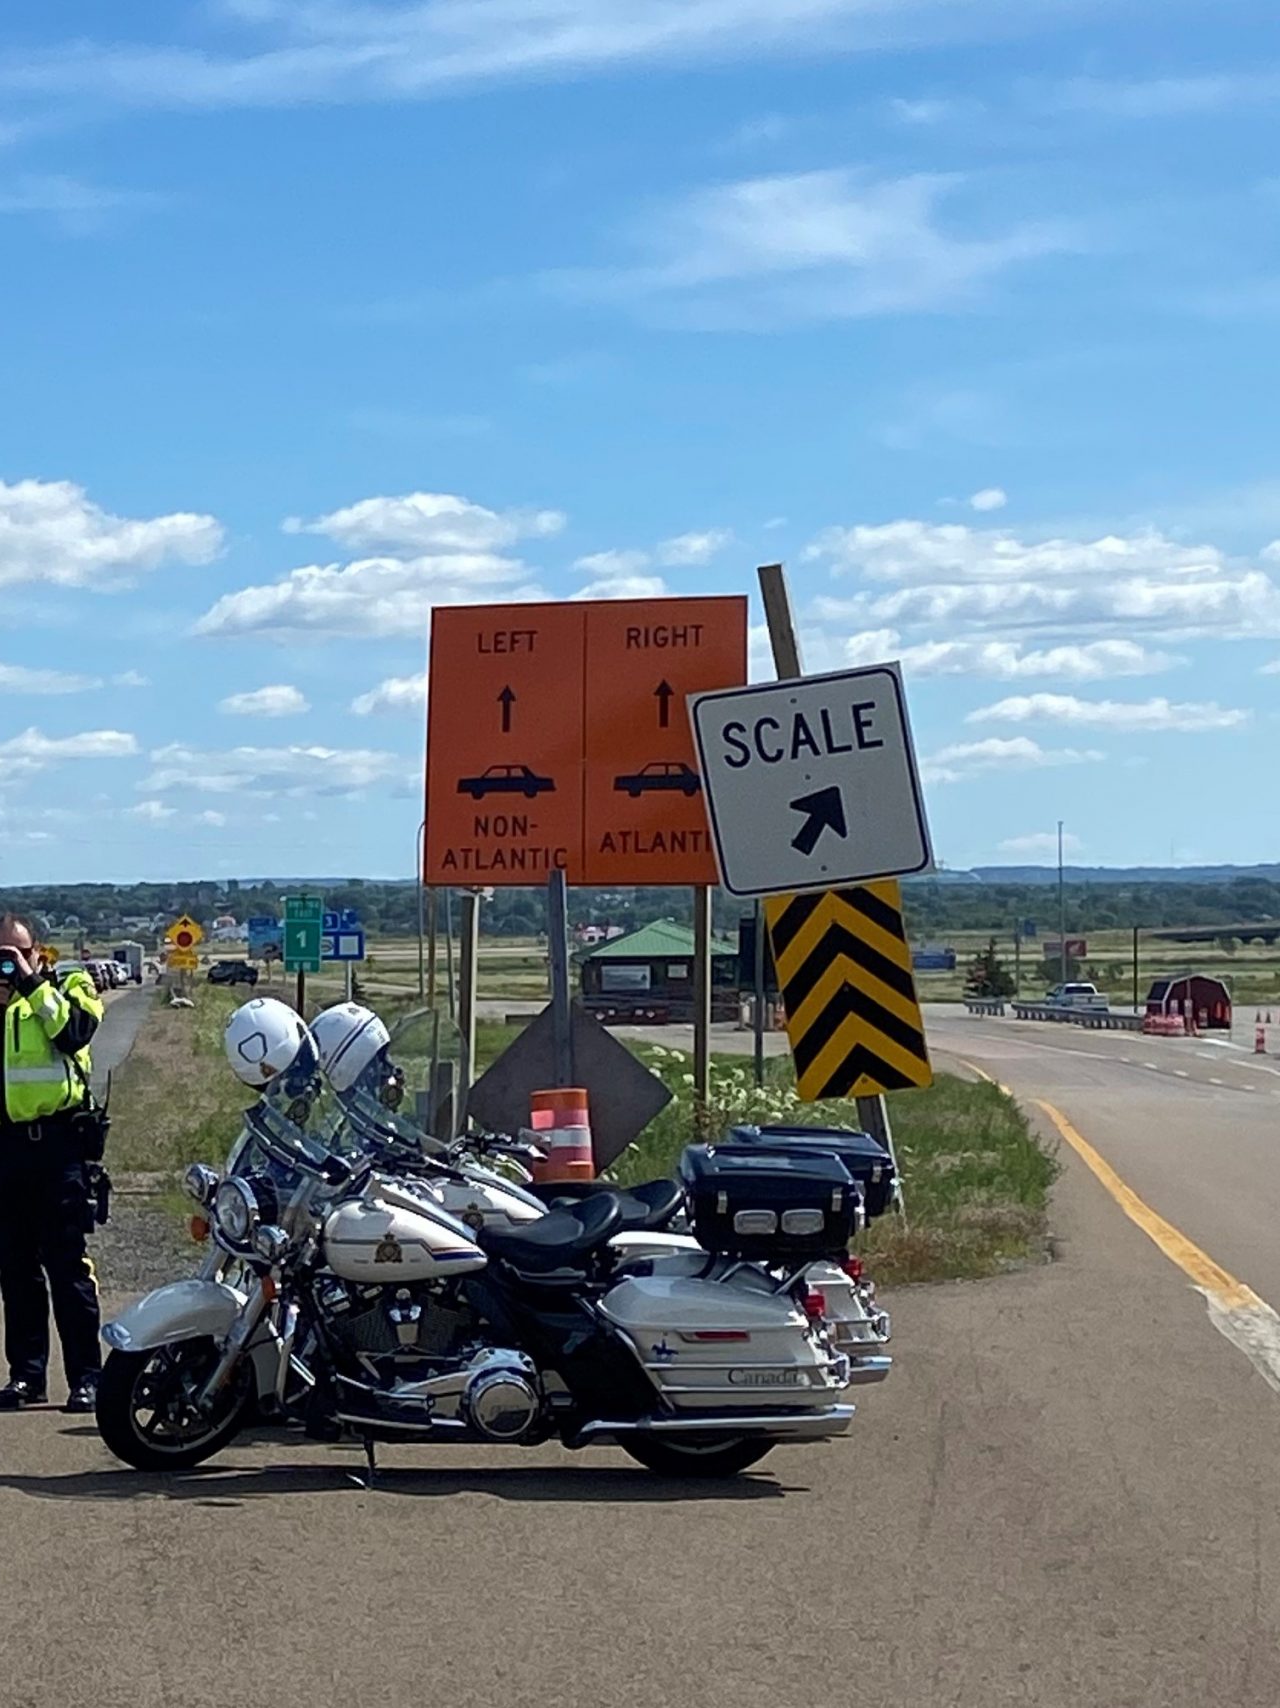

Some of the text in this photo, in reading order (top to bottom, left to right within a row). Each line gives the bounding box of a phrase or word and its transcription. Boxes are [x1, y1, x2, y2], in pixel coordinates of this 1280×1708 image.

[477, 629, 539, 654] LEFT
[625, 624, 705, 650] RIGHT
[722, 700, 884, 768] SCALE
[473, 815, 539, 838] NON-
[599, 829, 711, 854] ATLANTI
[441, 847, 568, 871] ATLANTIC
[728, 1367, 799, 1386] Canada
